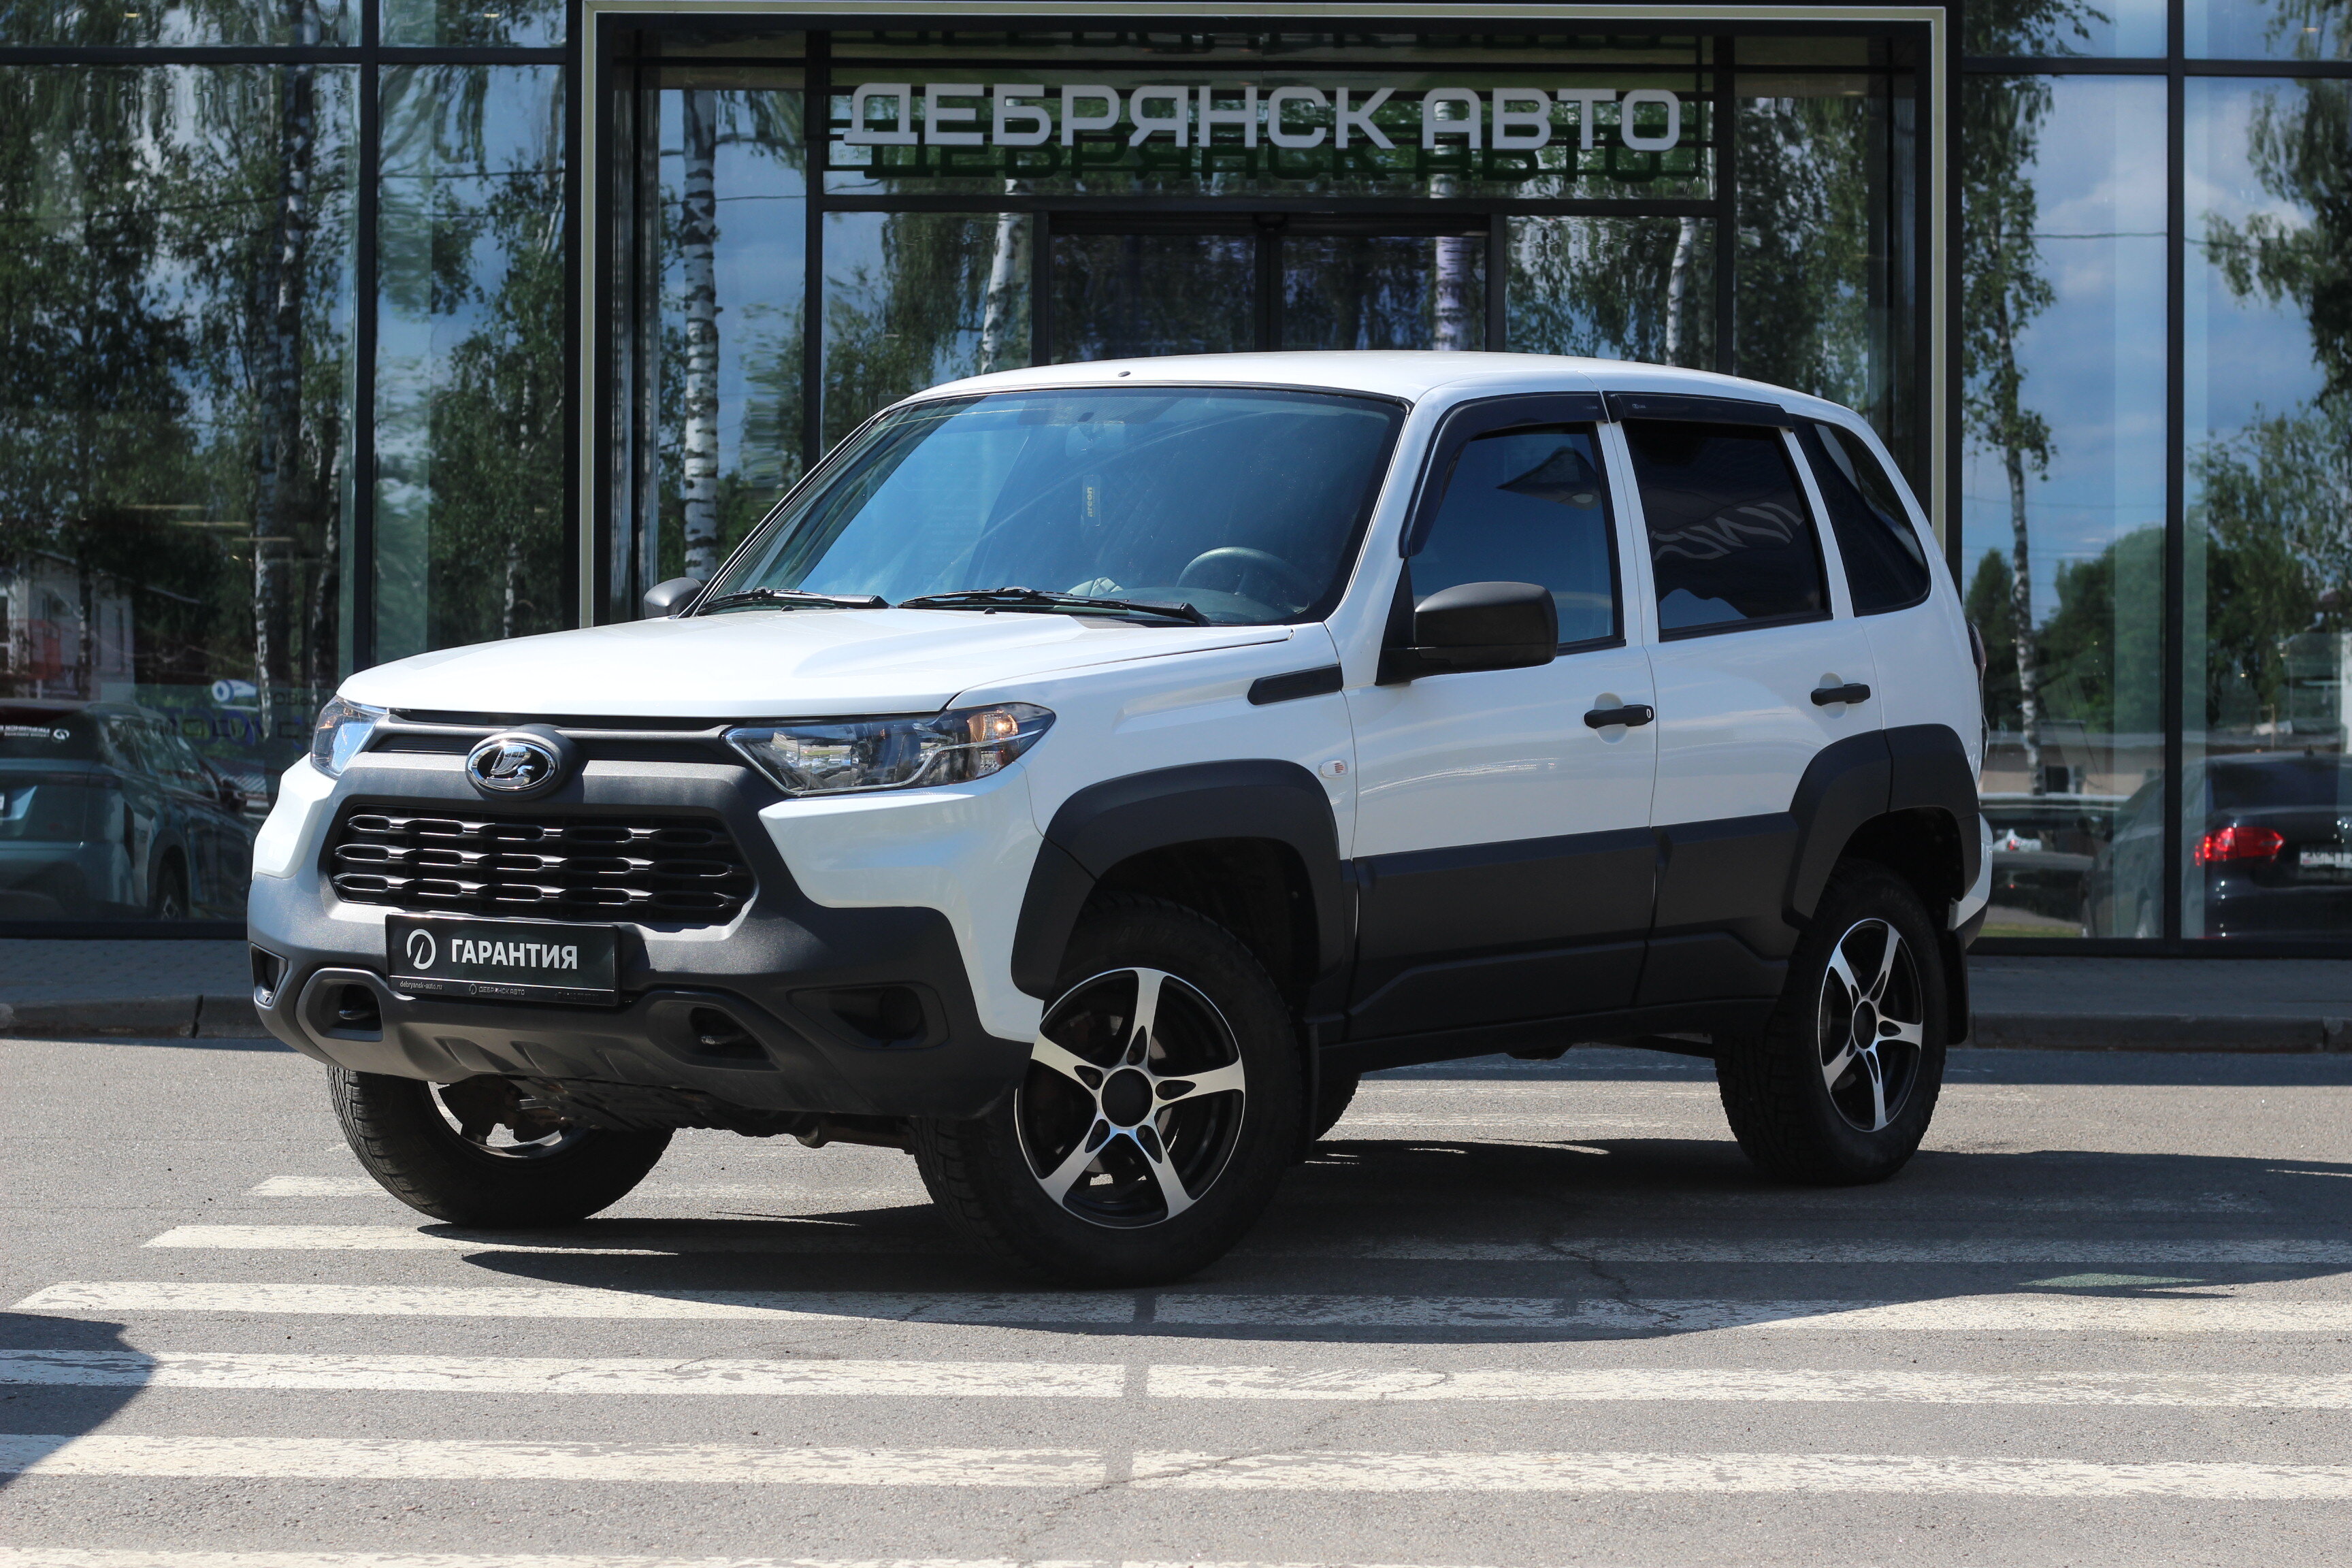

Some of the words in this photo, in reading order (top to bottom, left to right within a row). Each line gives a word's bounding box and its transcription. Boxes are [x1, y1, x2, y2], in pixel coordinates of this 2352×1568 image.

[843, 82, 1396, 149] ДЕБРЯНСК
[1422, 87, 1680, 151] АВТО
[452, 938, 578, 970] ГАРАНТИЯ
[399, 981, 442, 990] debryansk-auto.ru
[478, 986, 510, 994] ДЕБРЯНСК
